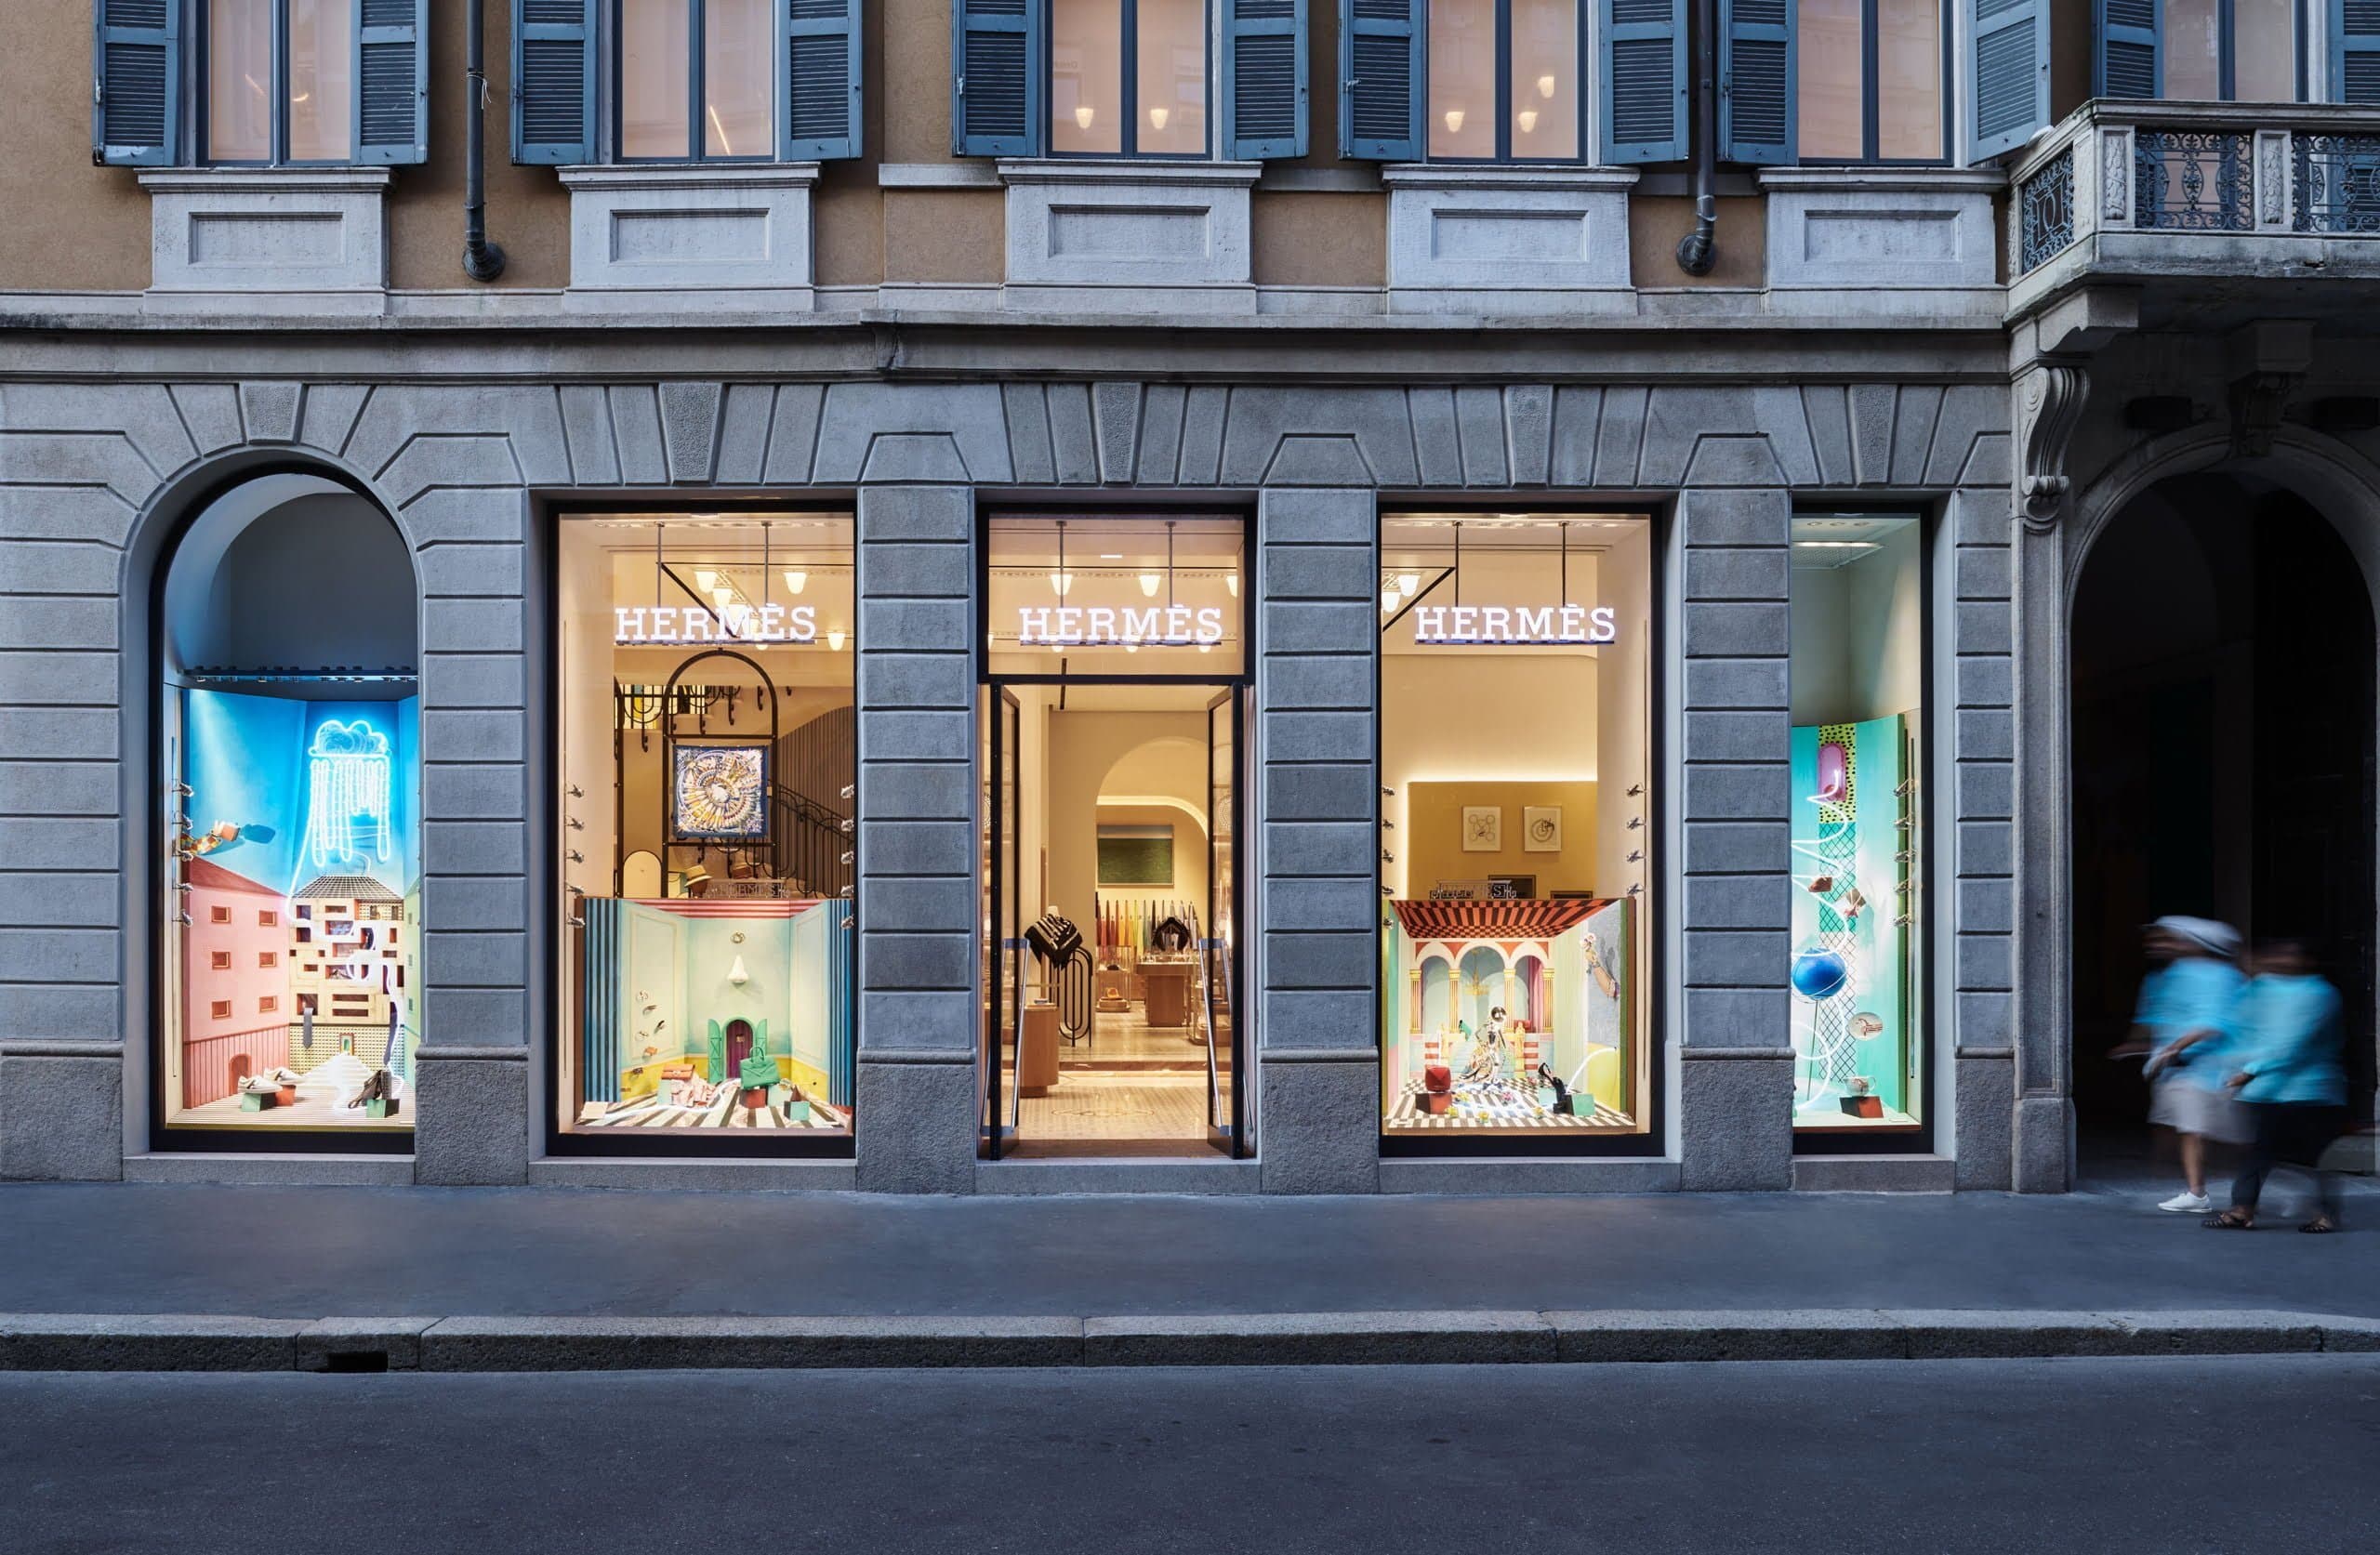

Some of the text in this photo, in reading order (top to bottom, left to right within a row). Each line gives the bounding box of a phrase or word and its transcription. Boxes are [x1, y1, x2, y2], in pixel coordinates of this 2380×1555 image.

[615, 602, 816, 640] HERMÈS
[1019, 604, 1223, 641] HERMÈS
[1415, 603, 1616, 640] HERMÈS
